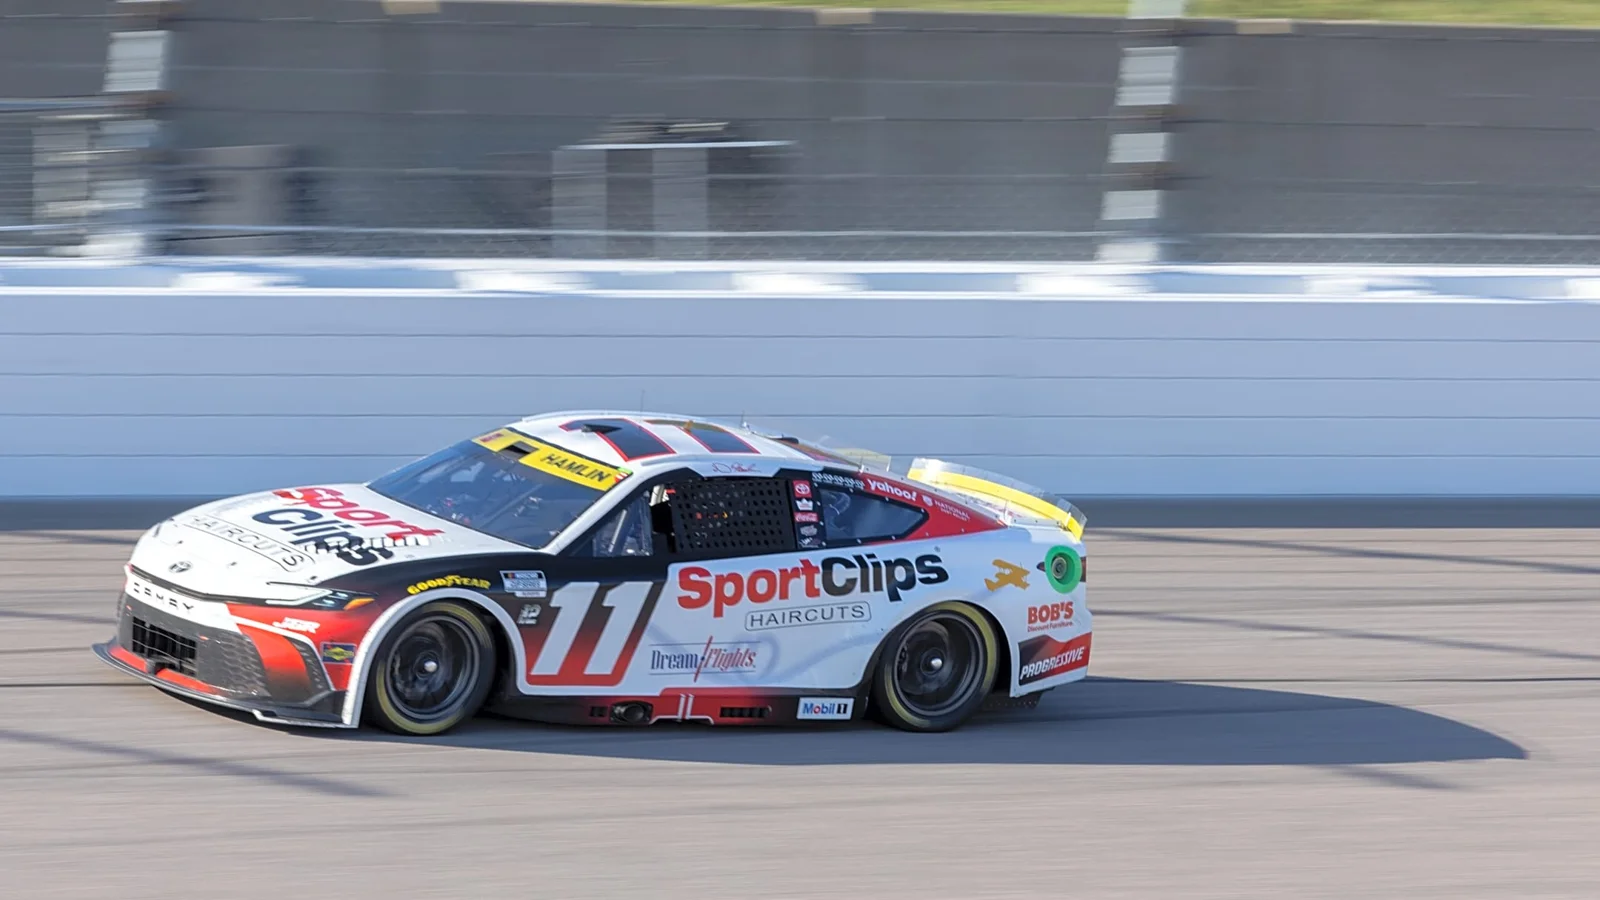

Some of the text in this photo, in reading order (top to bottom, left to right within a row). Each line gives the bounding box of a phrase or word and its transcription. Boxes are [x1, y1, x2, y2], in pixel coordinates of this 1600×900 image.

[540, 454, 611, 482] HAMLIN
[866, 478, 917, 501] yahoo!
[272, 487, 446, 541] Sport
[251, 508, 394, 566] Clips
[406, 575, 491, 595] GOODYEAR
[750, 605, 865, 628] HAIRCUTS
[1028, 601, 1074, 625] BOB'S
[530, 582, 653, 675] 11
[1028, 625, 1049, 633] Discount
[651, 650, 699, 669] Dream
[1020, 646, 1085, 680] PROGRESSIVE
[802, 703, 835, 714] Mobil
